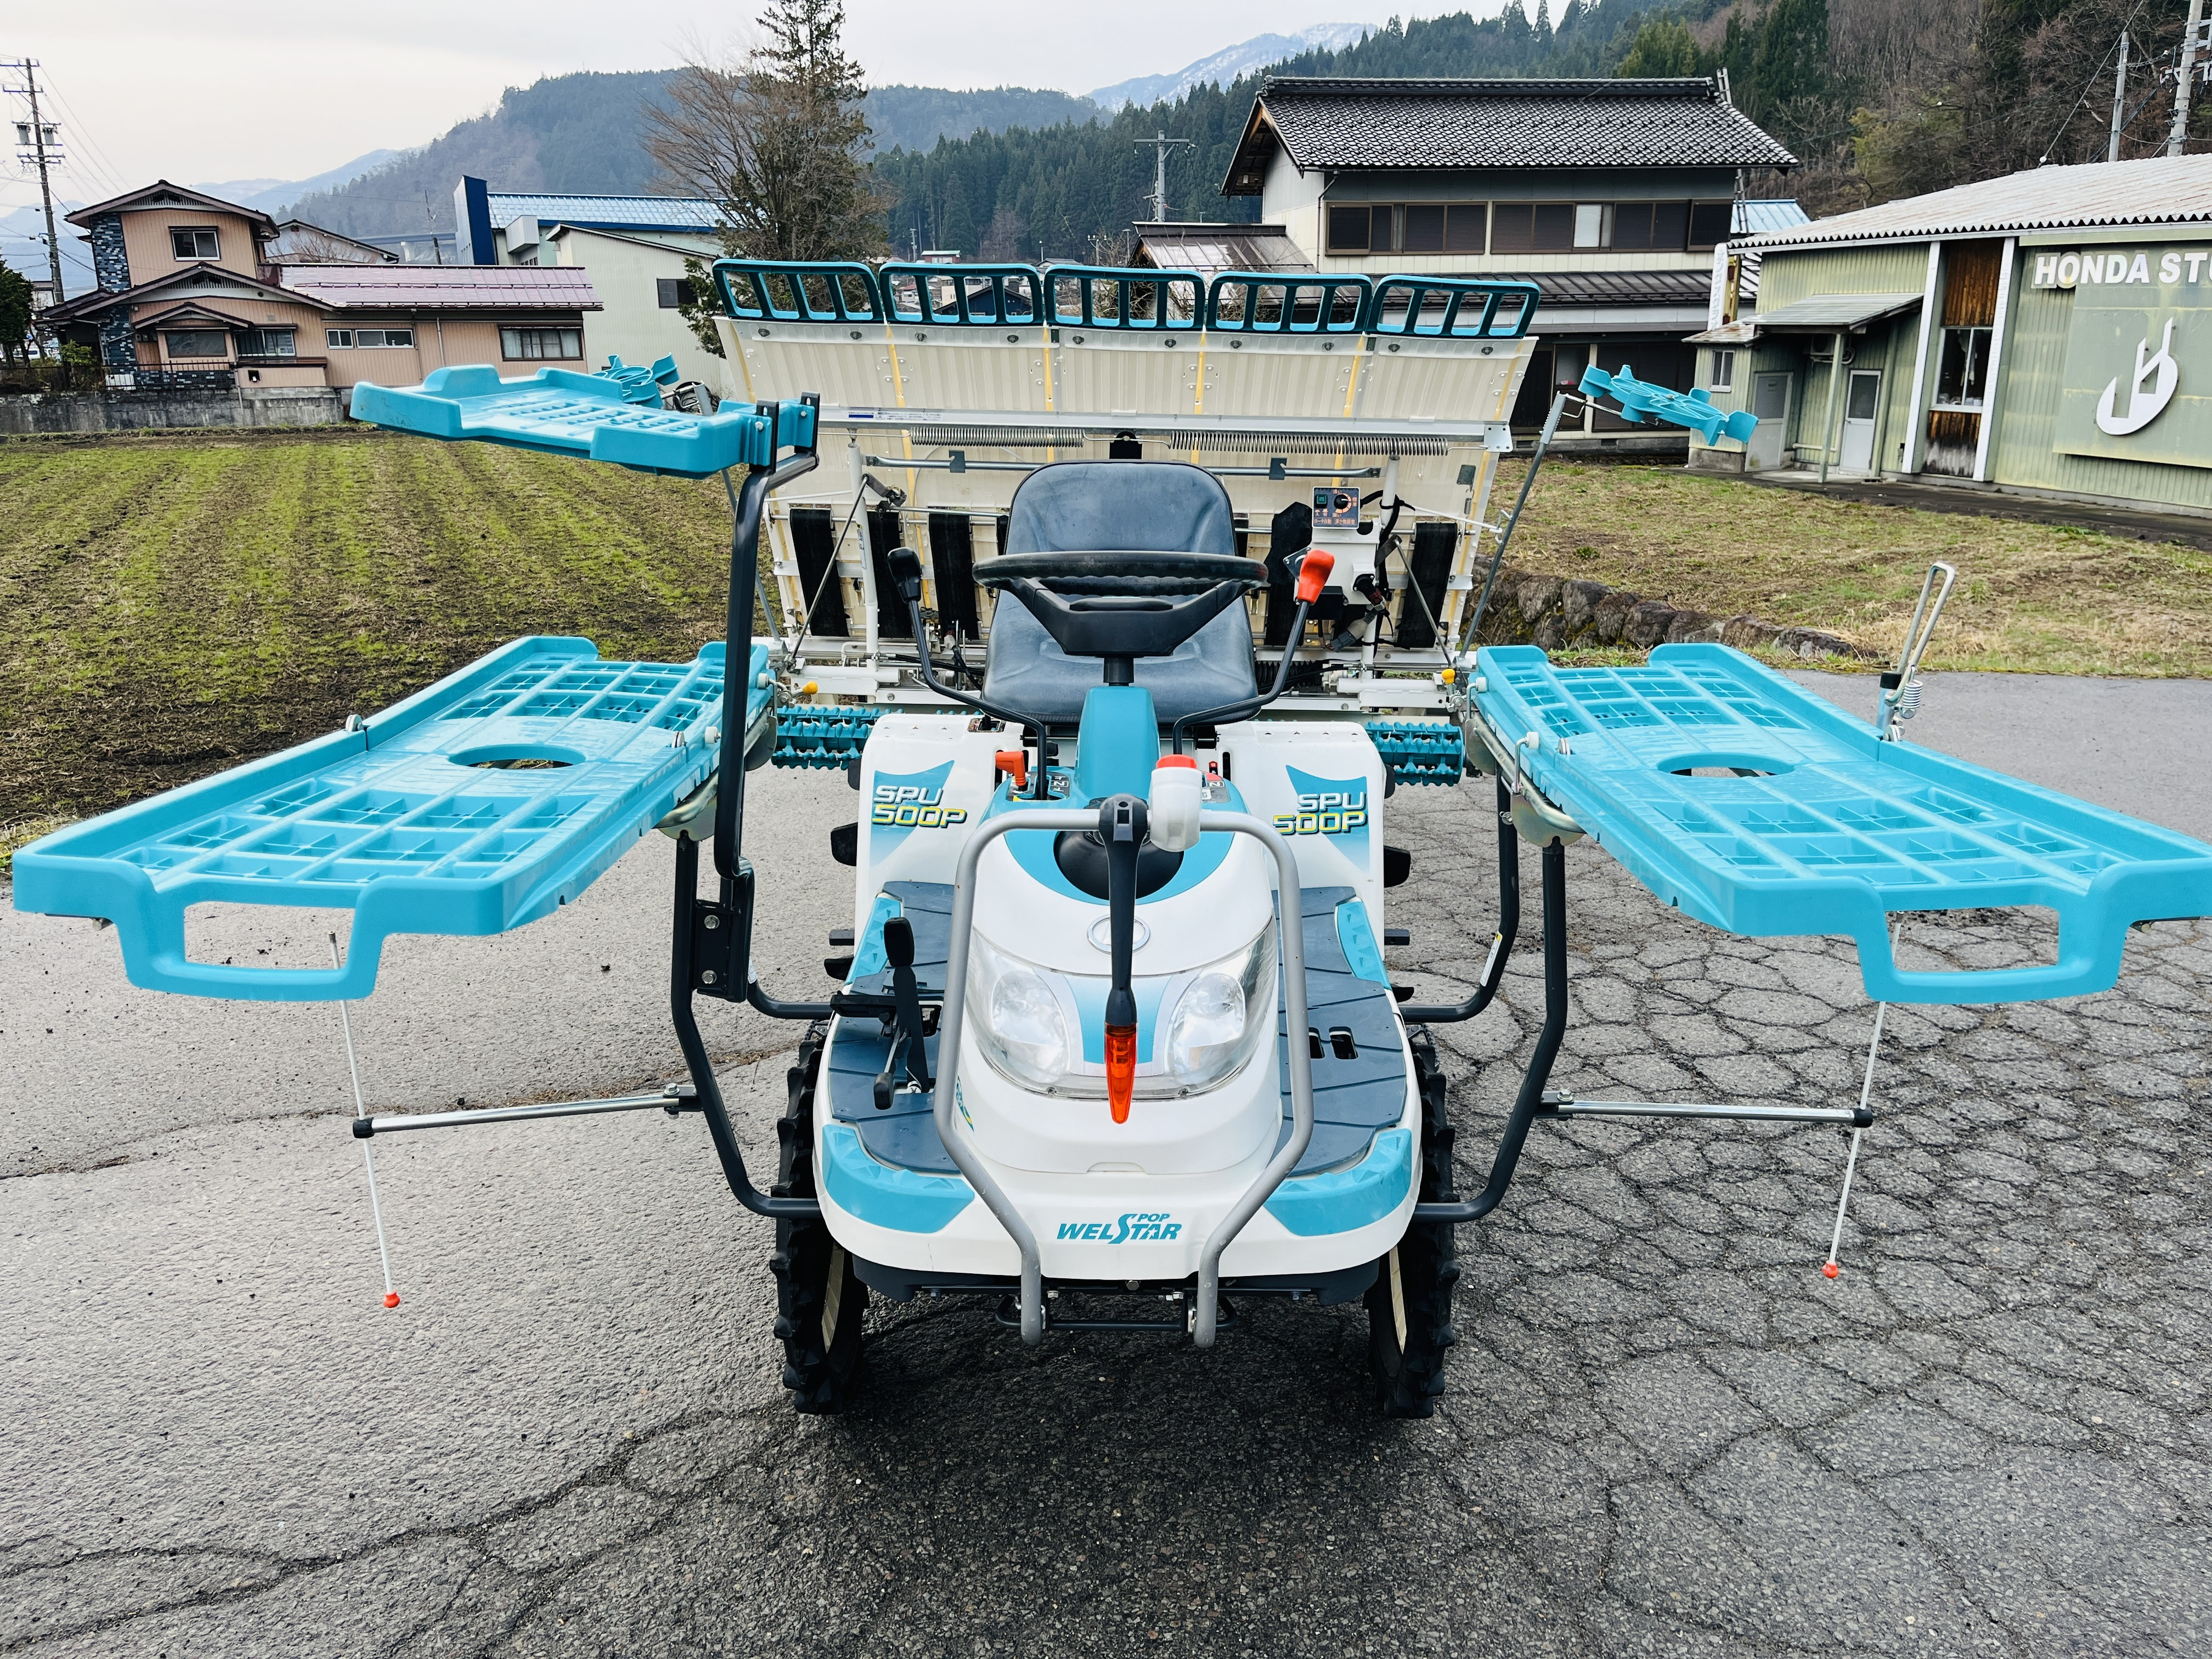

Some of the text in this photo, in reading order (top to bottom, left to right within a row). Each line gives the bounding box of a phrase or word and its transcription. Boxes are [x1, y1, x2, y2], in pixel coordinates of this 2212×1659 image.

[2034, 252, 2212, 285] HONDA ST
[873, 785, 943, 805] SPU
[1297, 792, 1367, 812] SPU
[872, 804, 967, 830] 500P
[1273, 811, 1368, 835] 500P
[1057, 1214, 1182, 1244] WELSTAR
[1137, 1214, 1170, 1222] POP
